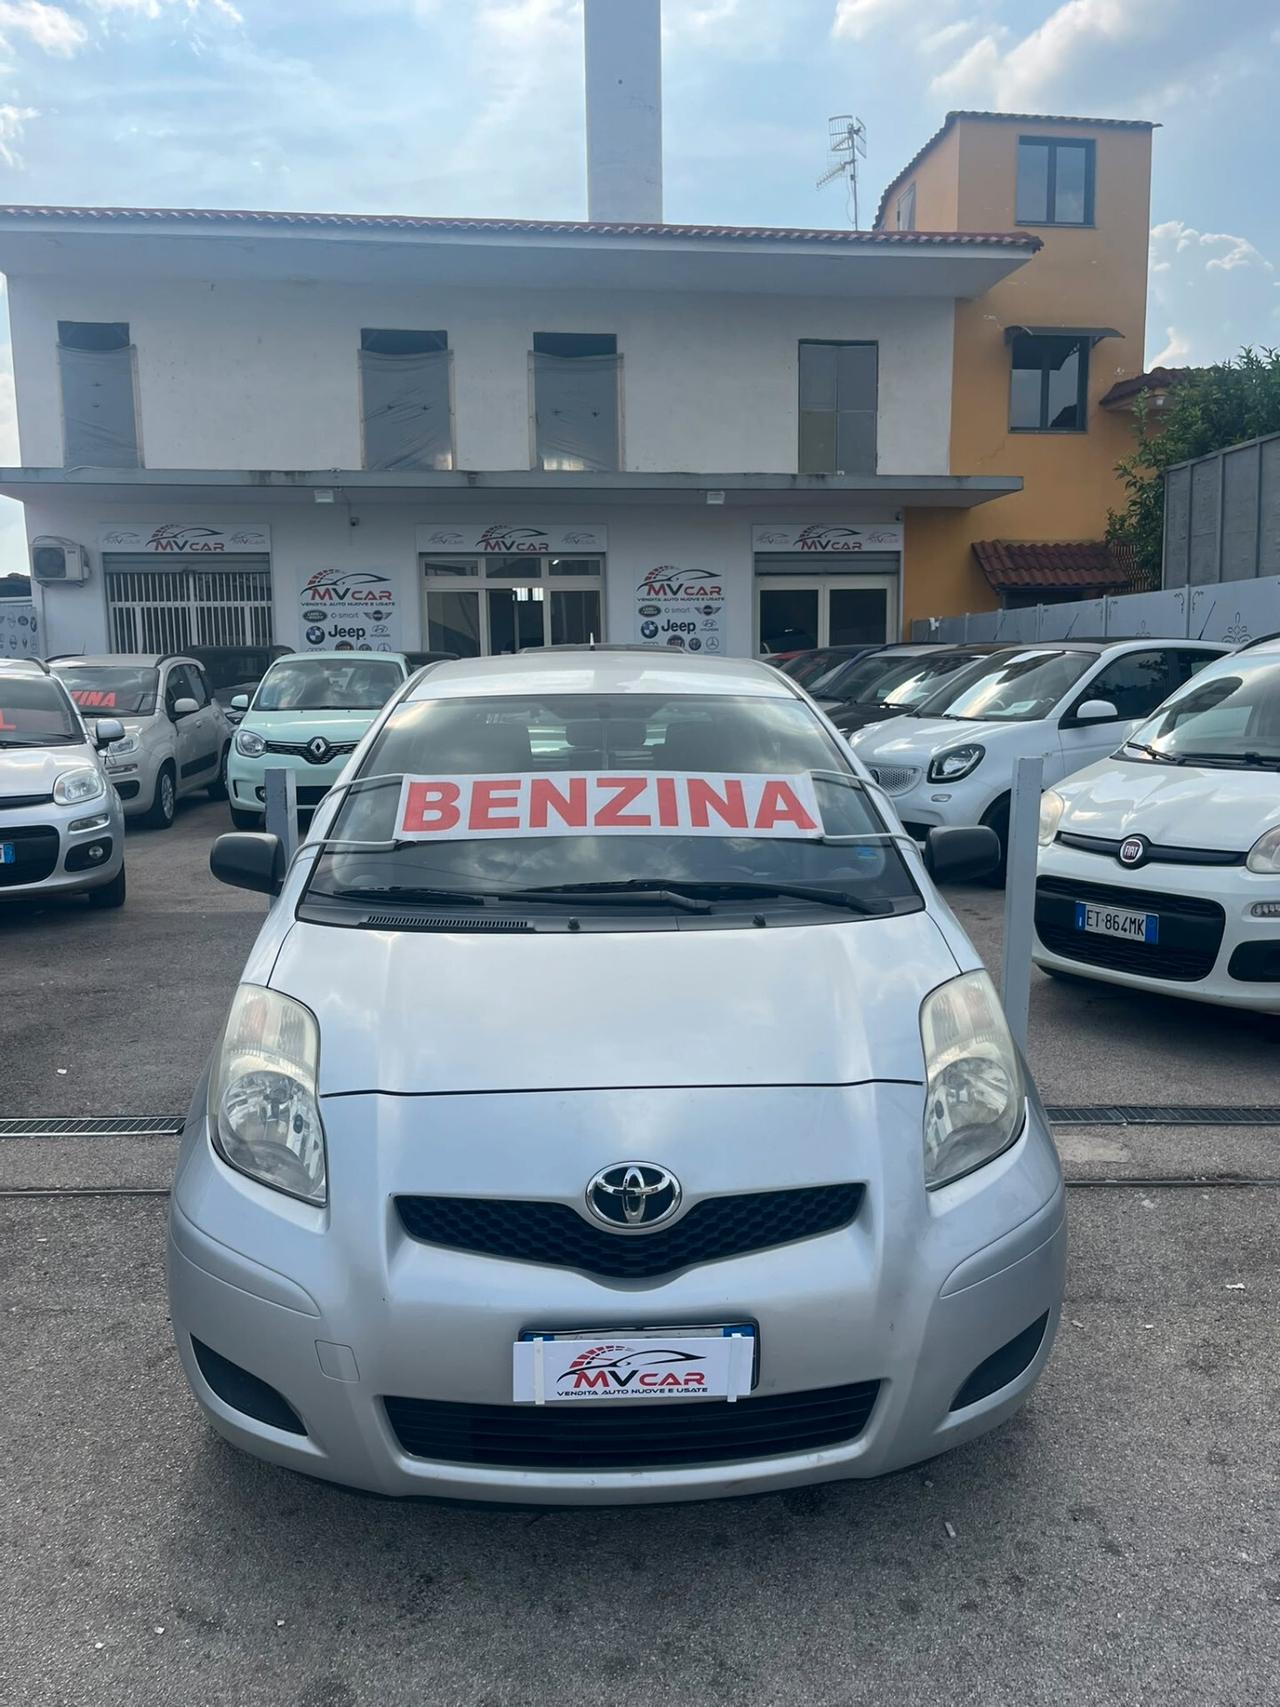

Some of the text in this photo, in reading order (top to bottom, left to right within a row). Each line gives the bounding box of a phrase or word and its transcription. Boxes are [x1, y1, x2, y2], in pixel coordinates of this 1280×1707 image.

[328, 624, 366, 640] Jeep
[661, 619, 696, 634] Jeep
[402, 777, 819, 833] BENZINA
[1124, 845, 1139, 857] FIAT
